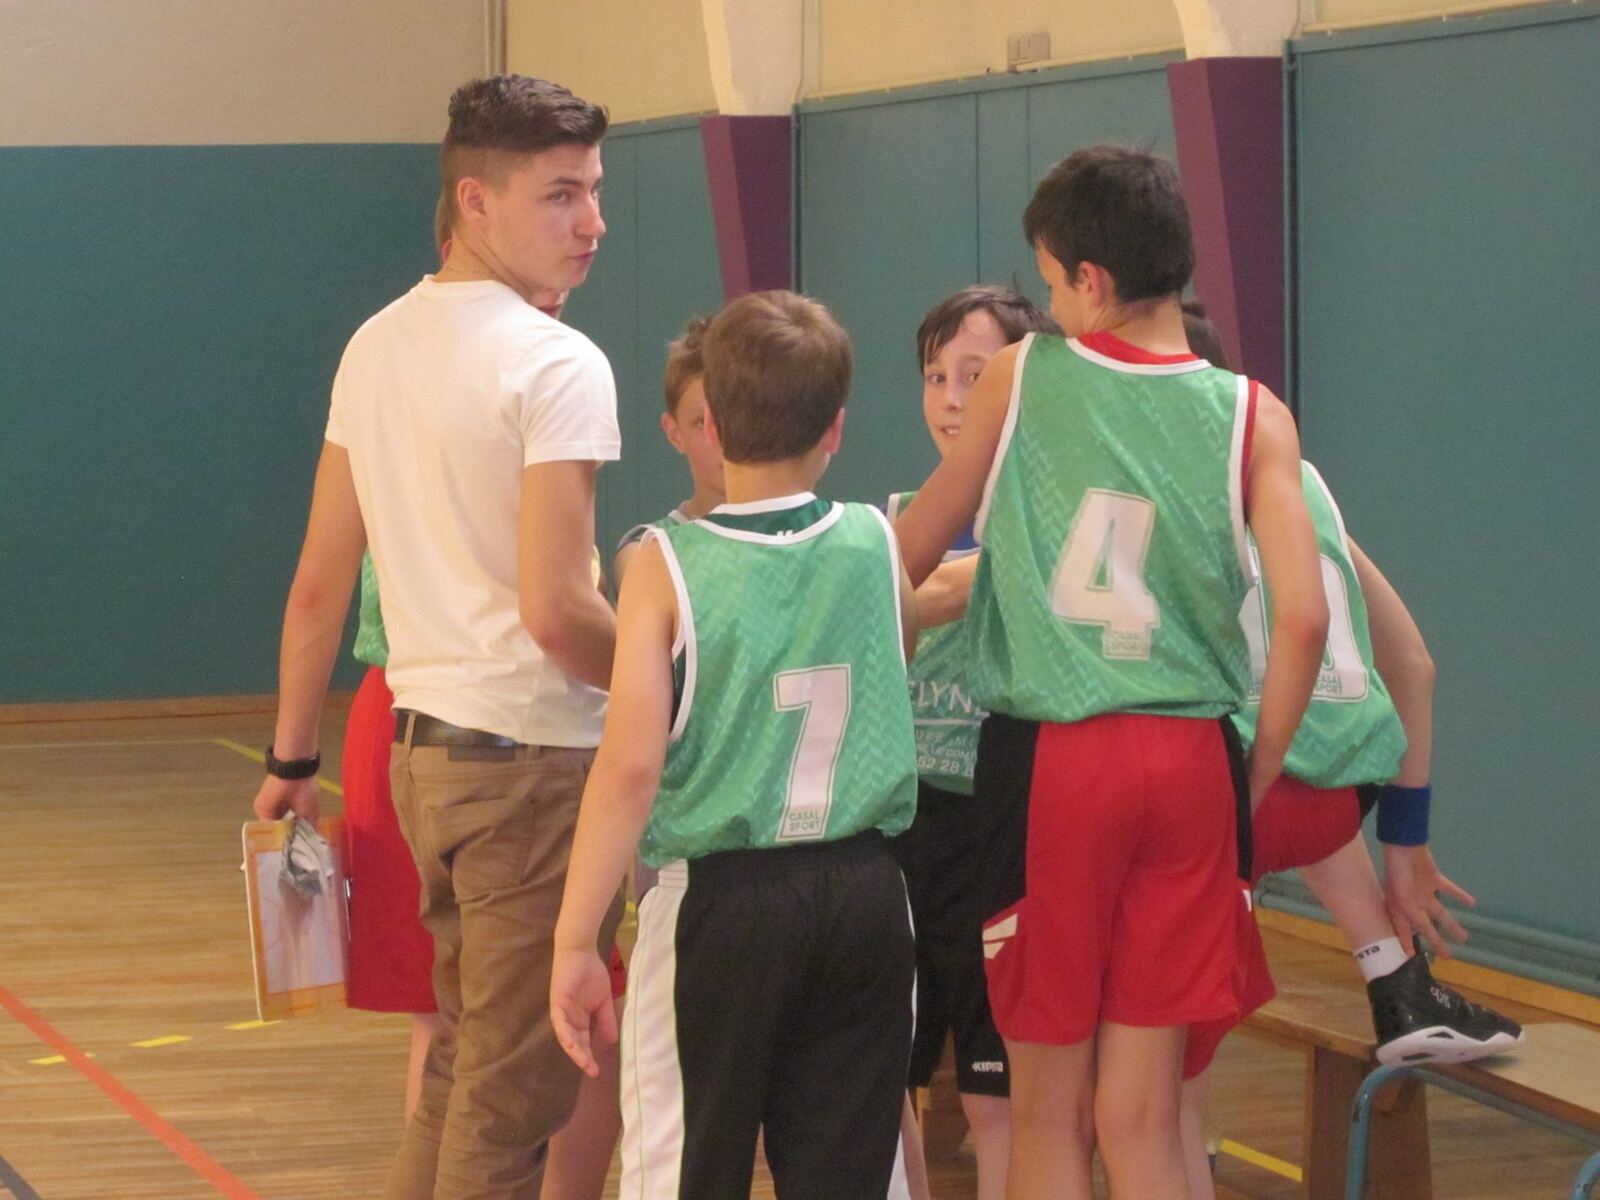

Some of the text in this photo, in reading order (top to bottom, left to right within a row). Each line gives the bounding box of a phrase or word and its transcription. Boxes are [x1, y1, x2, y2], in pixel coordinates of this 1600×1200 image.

[1050, 487, 1161, 660] 4
[773, 663, 851, 842] 7
[940, 760, 960, 775] 28
[789, 810, 820, 822] CASAL
[790, 820, 820, 832] SPORT
